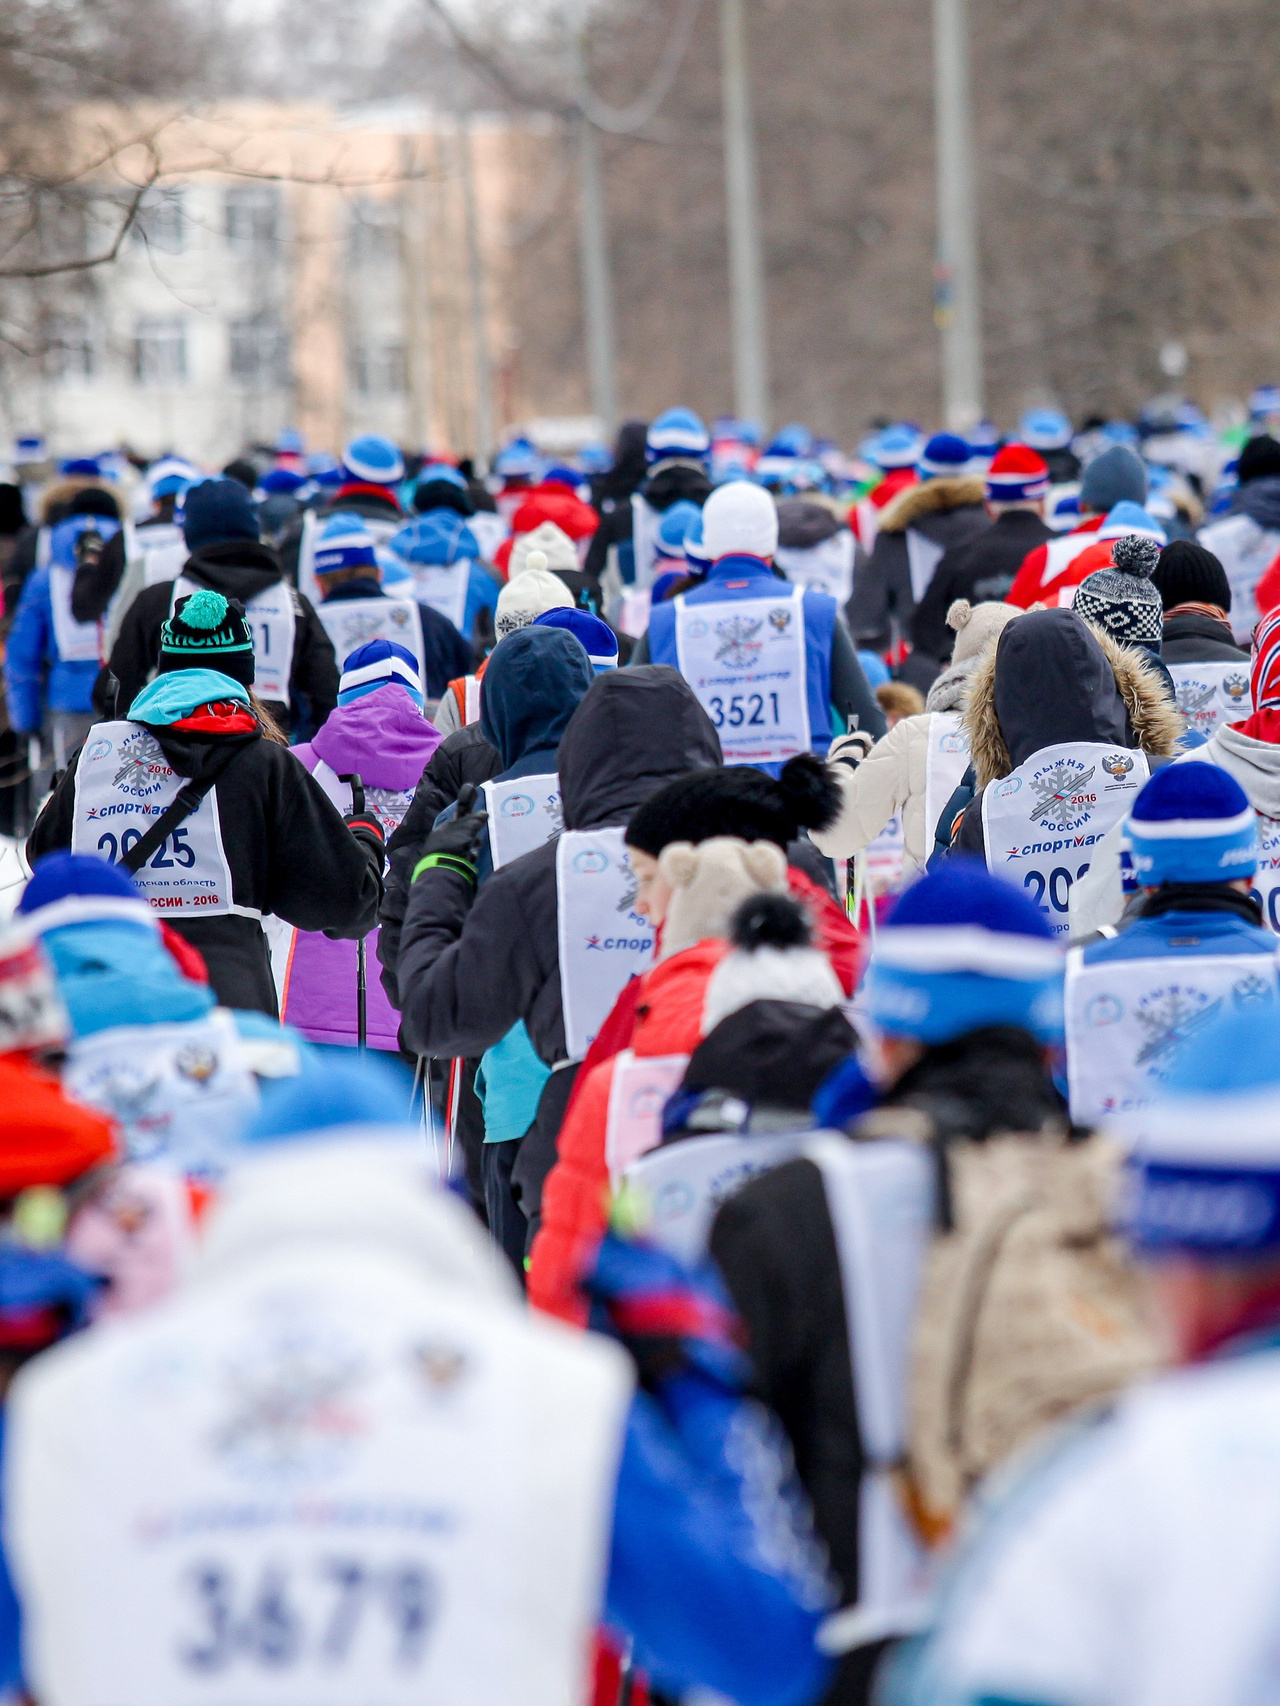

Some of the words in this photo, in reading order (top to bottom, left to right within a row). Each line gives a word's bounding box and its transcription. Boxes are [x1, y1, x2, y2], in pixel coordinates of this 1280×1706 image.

[710, 692, 780, 728] 3521
[148, 764, 173, 776] 2016
[1033, 758, 1086, 780] ЛЫЖНЯ
[118, 782, 162, 797] РОССИИ
[1070, 793, 1097, 805] 2016
[1040, 812, 1091, 832] РОССИИ
[173, 878, 216, 887] область
[193, 894, 219, 906] 2016
